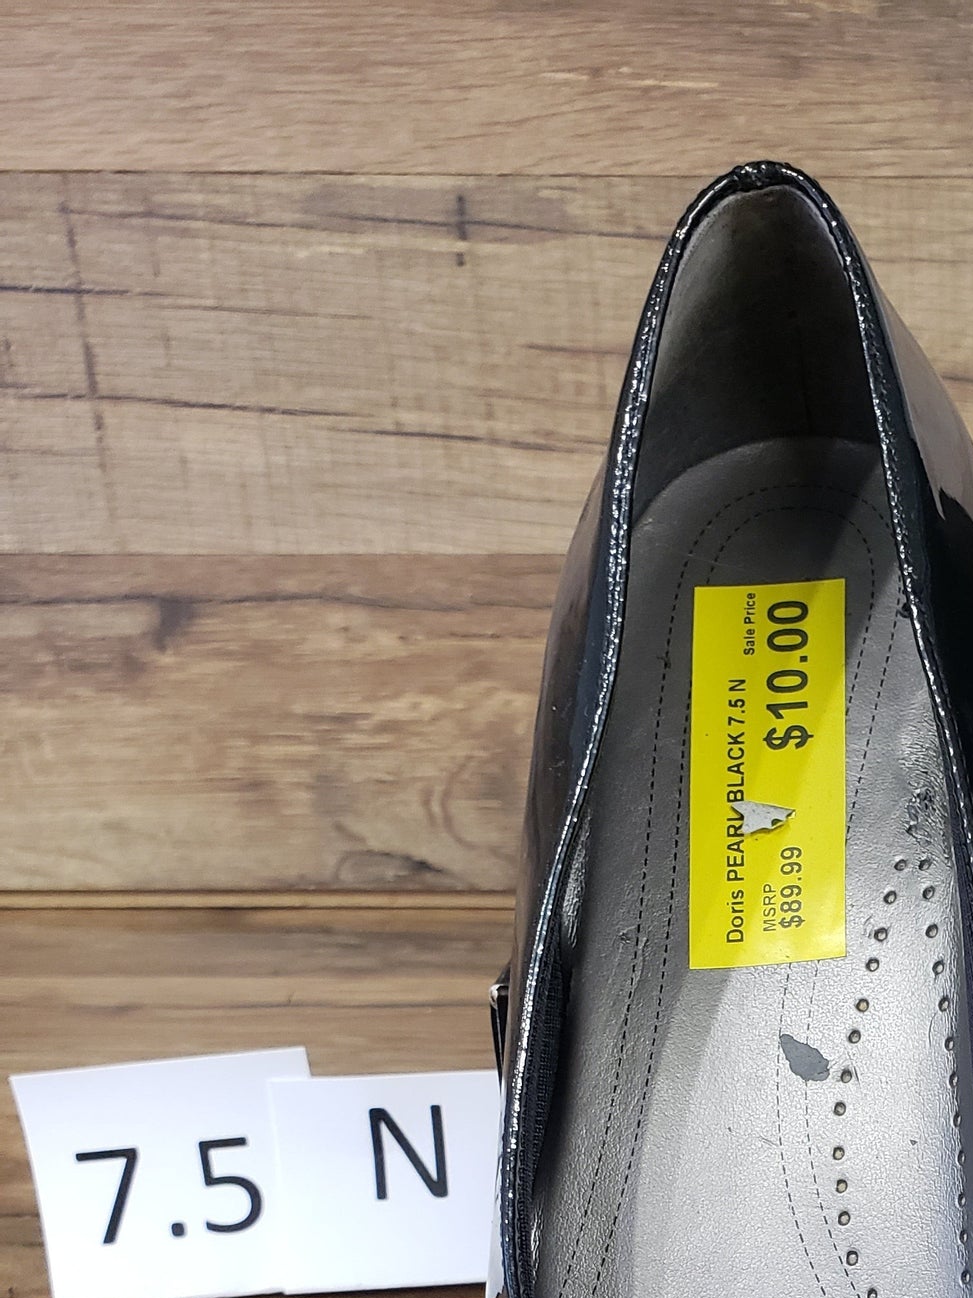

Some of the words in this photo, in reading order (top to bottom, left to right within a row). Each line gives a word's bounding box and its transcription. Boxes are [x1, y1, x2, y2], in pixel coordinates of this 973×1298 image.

[743, 592, 756, 625] Price
[743, 627, 756, 656] Sale
[728, 679, 747, 692] N
[763, 600, 814, 751] $10.00
[727, 698, 746, 726] 7.5
[726, 731, 746, 803] BLACK
[762, 883, 777, 932] MSRP
[778, 846, 806, 929] $89.99
[726, 889, 745, 943] Doris
[368, 1103, 450, 1201] N
[74, 1136, 265, 1245] 7.5
